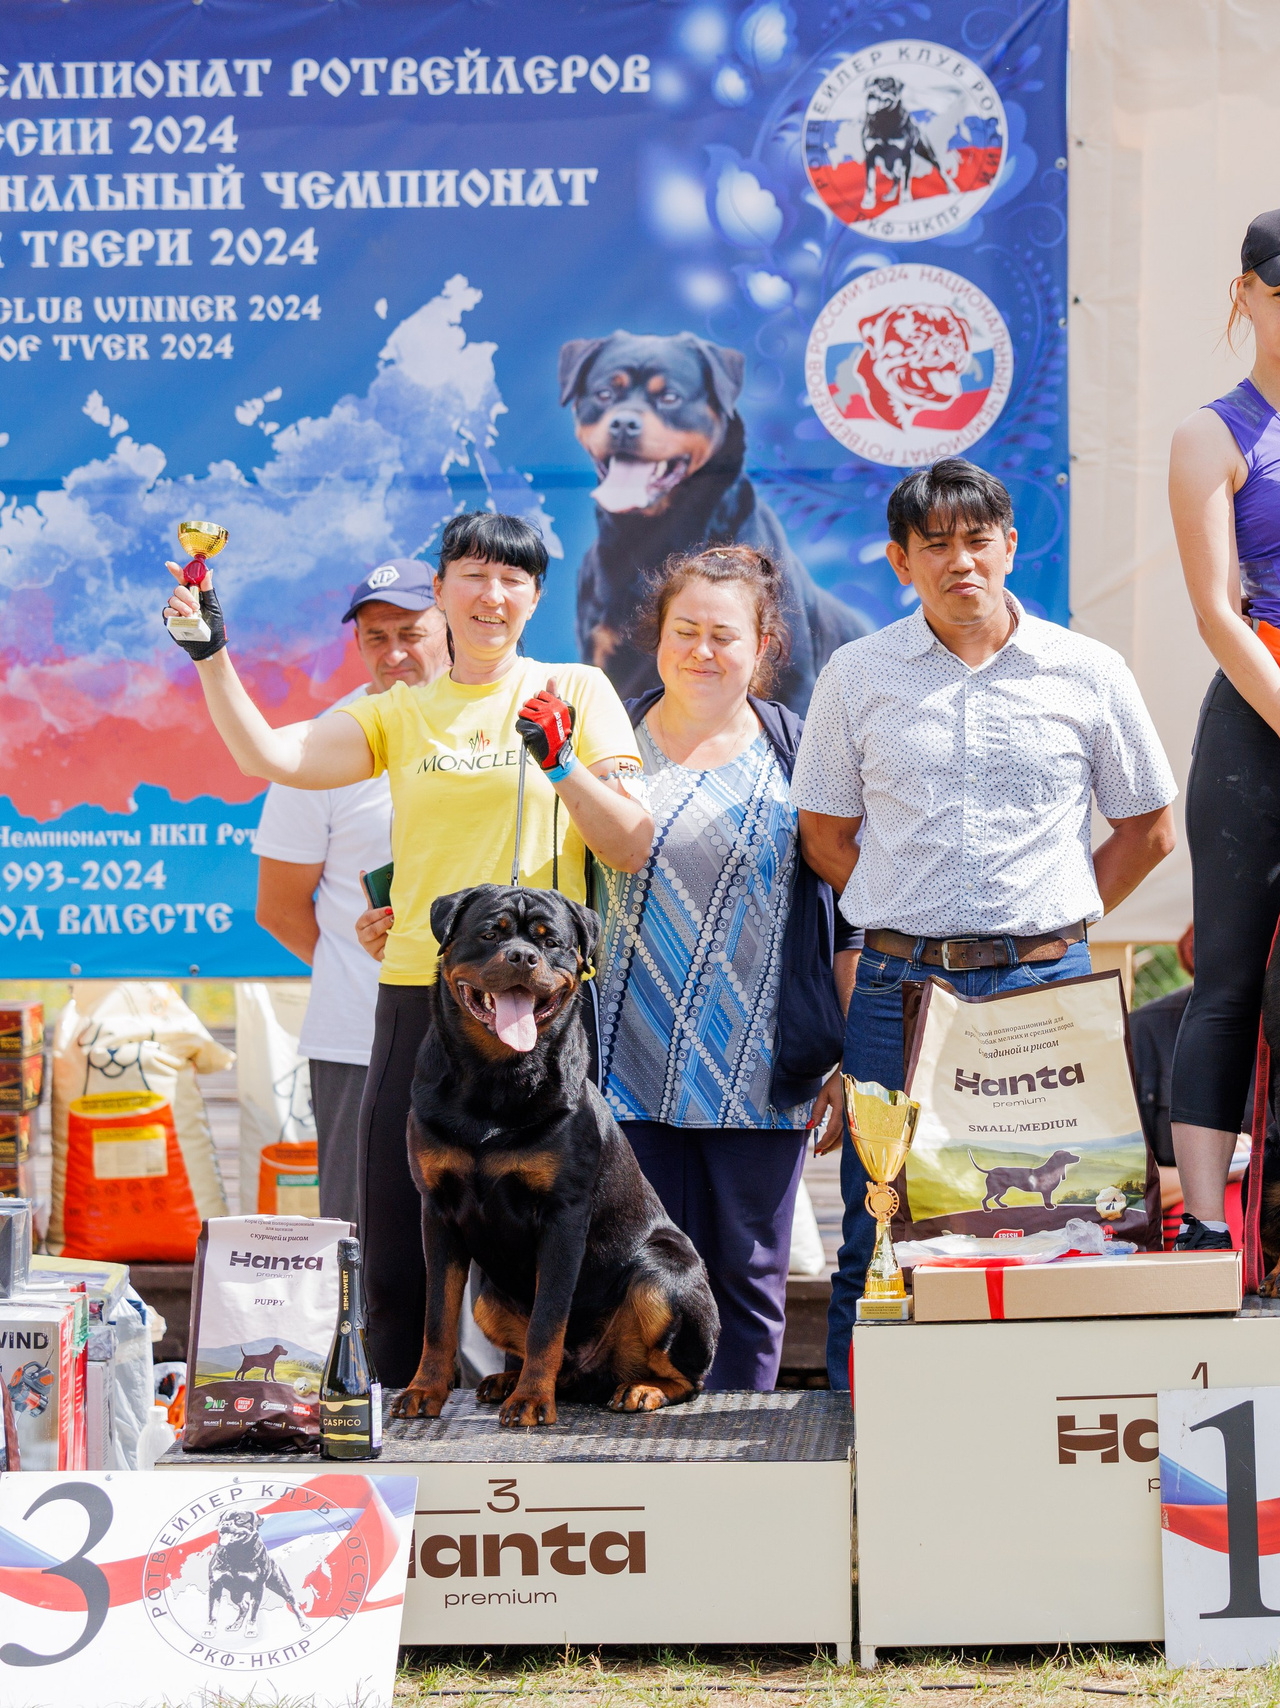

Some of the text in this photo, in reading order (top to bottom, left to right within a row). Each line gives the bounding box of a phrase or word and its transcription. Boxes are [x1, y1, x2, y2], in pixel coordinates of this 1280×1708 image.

[0, 47, 652, 100] МПИОНАТ РОТВЕЙЛЕРОВ
[898, 47, 965, 78] КЛУБ
[0, 115, 239, 157] СИИ 2024
[261, 167, 600, 210] ЧЕМПИОНАТ
[20, 227, 320, 268] ТВЕРИ 2024
[864, 266, 909, 290] 2024
[93, 295, 238, 323] WINNER
[248, 294, 322, 322] 2024
[0, 332, 235, 362] OF TVER 2024
[417, 749, 534, 774] MONCLER
[150, 823, 208, 847] НКП
[2, 859, 167, 892] 993-2024
[57, 903, 234, 935] ВМЕСТЕ
[1030, 1039, 1060, 1054] рисом
[954, 1062, 1086, 1097] Hanta
[992, 1095, 1047, 1109] premium
[968, 1118, 1078, 1134] SMALL/MEDIUM
[287, 1235, 309, 1243] рисом
[229, 1250, 323, 1272] Hanta
[256, 1271, 293, 1279] premium
[254, 1298, 285, 1307] PUPPY
[1190, 1362, 1208, 1389] 1
[323, 1418, 361, 1427] CASPICO
[486, 1478, 520, 1513] 3
[147, 1484, 367, 1622] РОТВЕЙЛЕР КЛУБ РОССИИ
[407, 1522, 647, 1579] anta
[0, 1481, 114, 1667] 3
[444, 1588, 557, 1609] premium
[189, 1639, 312, 1669] РКФ-НКПР
